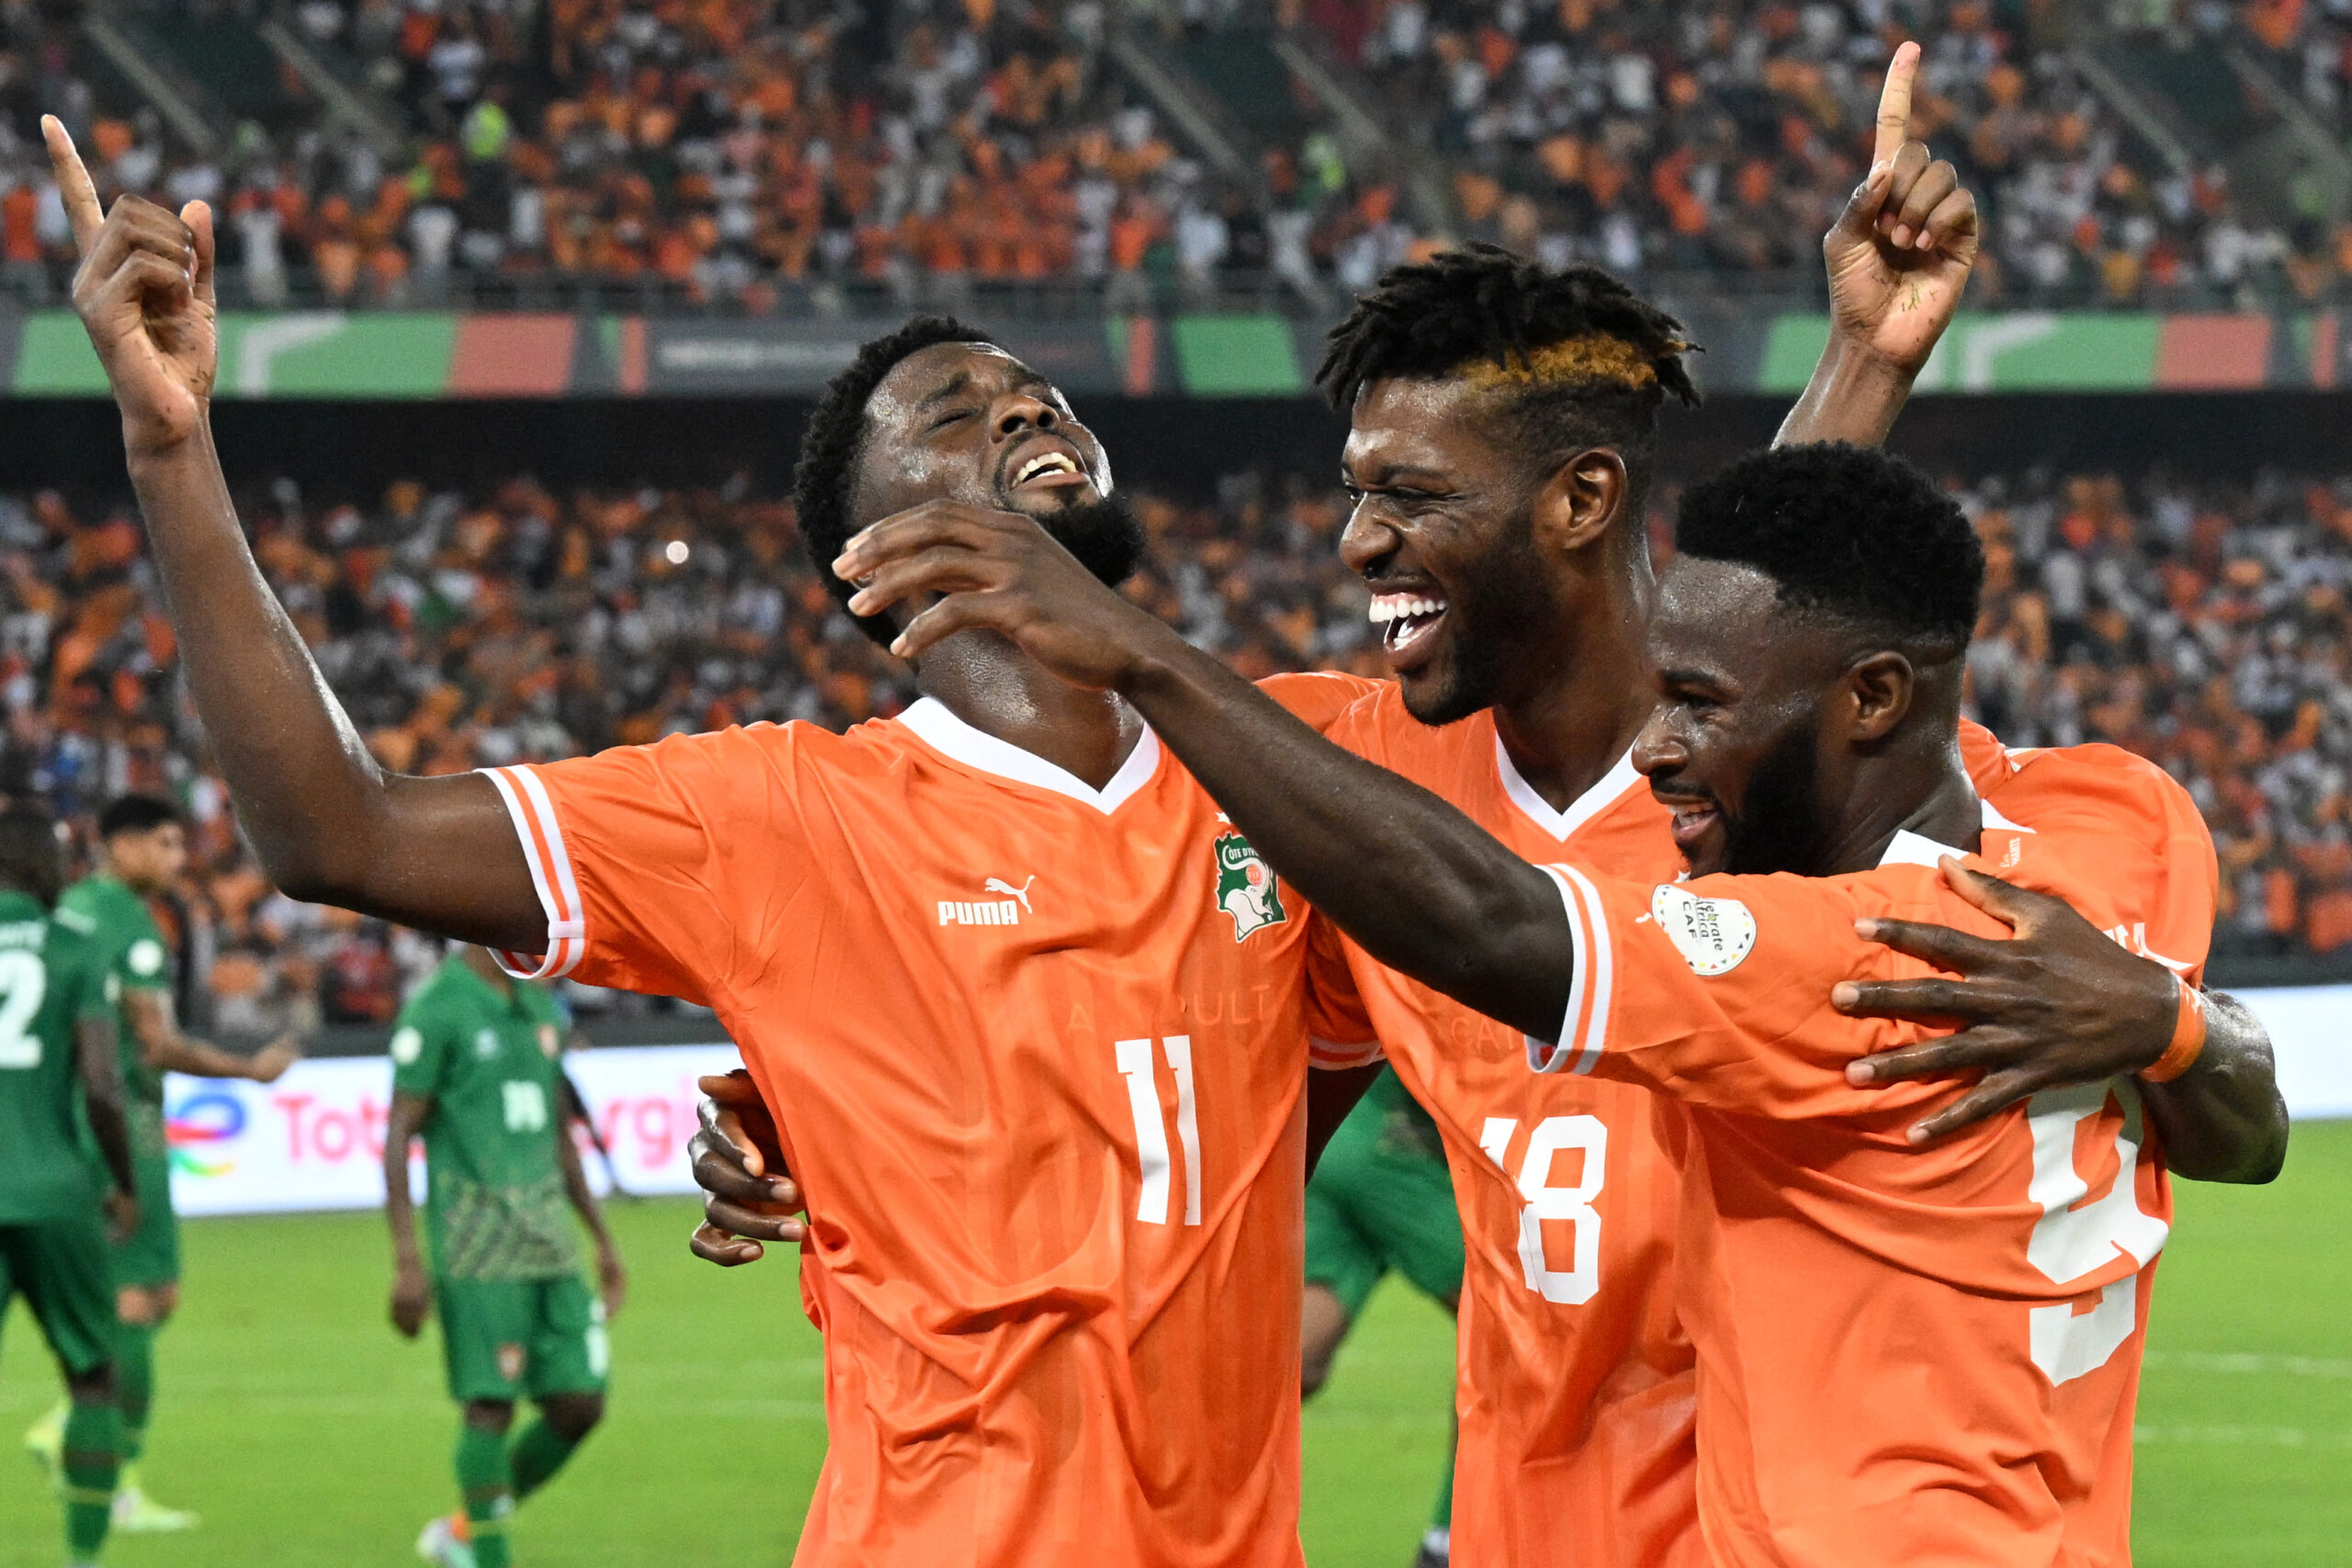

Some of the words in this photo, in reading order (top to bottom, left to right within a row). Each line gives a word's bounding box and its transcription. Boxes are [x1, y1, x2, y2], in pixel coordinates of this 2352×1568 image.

[937, 900, 1019, 926] PUMA
[1682, 901, 1698, 940] CAF
[1114, 1034, 1202, 1226] 11
[1479, 1114, 1608, 1305] 18
